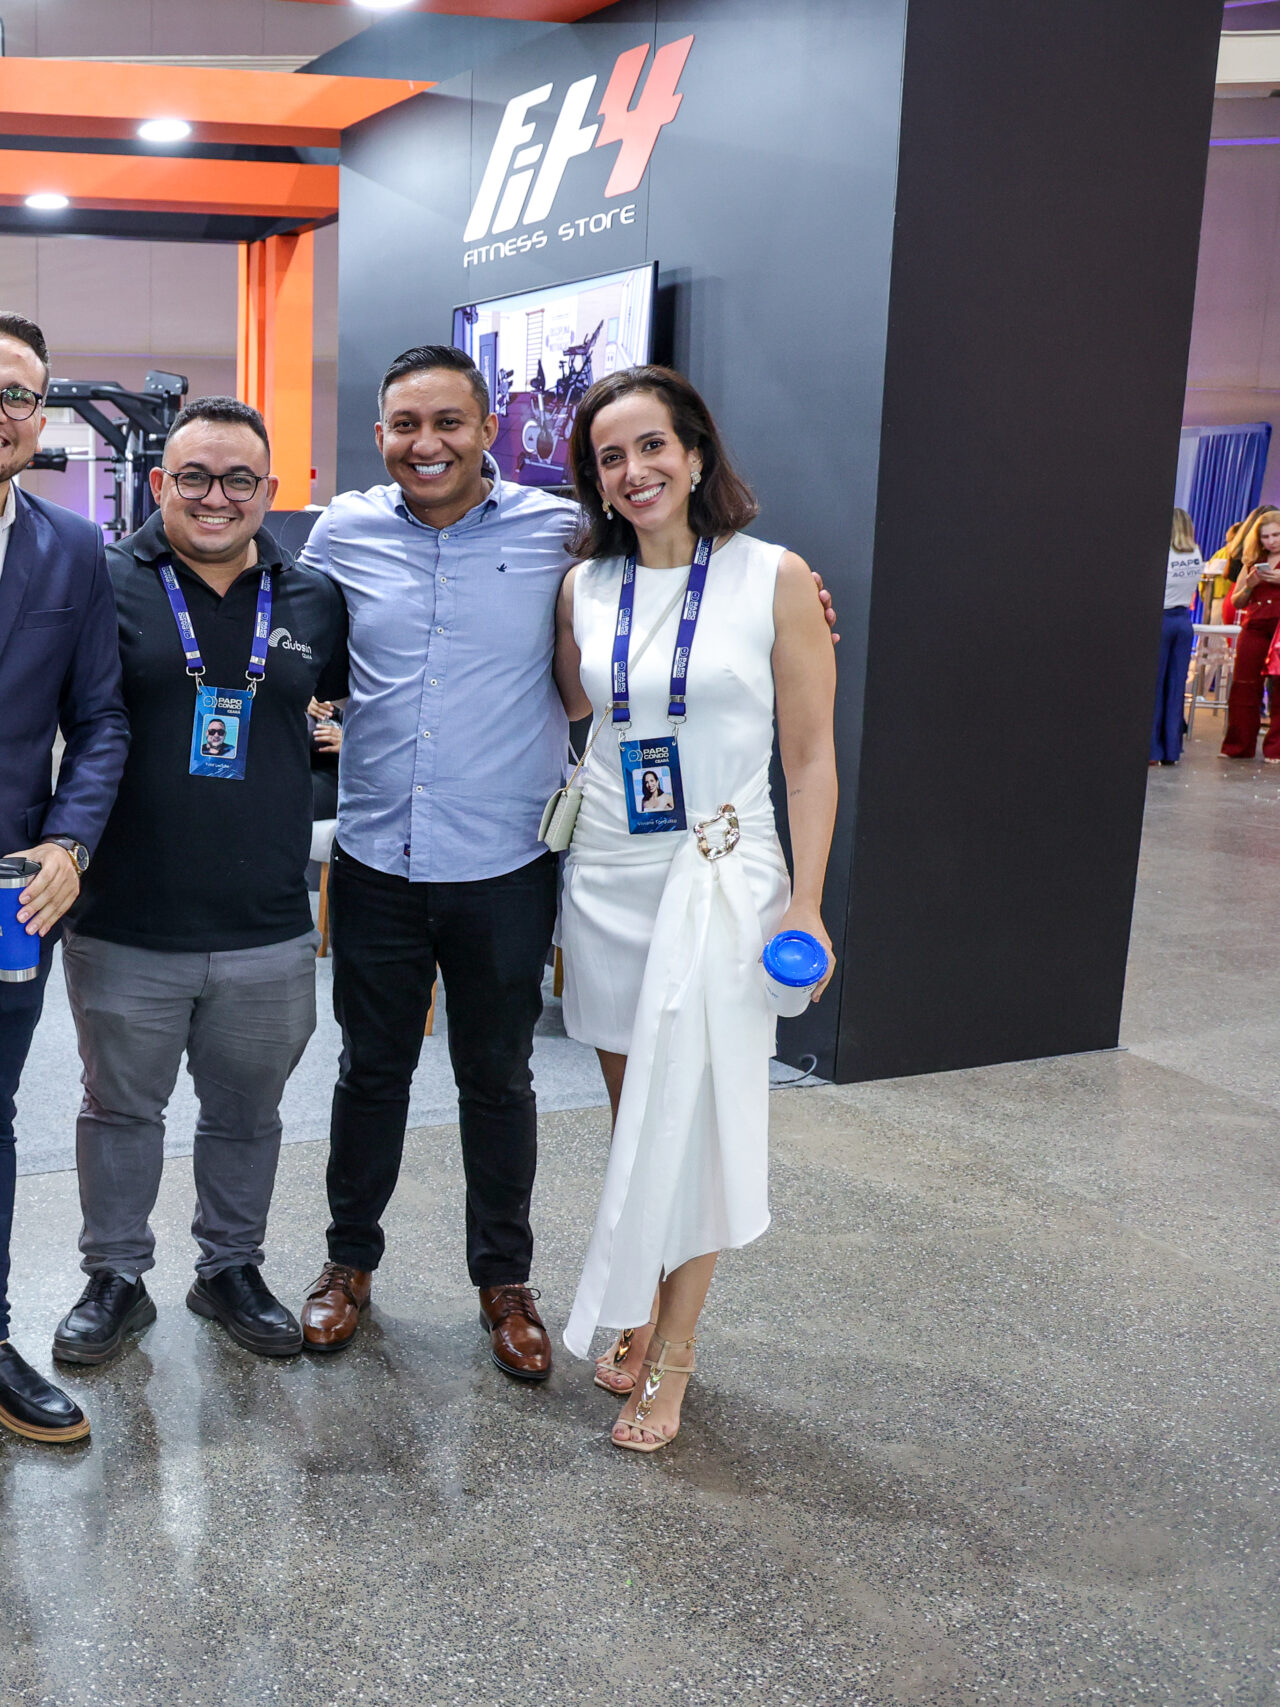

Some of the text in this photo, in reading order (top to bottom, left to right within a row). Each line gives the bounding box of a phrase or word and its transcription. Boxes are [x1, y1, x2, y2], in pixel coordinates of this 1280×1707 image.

[463, 204, 636, 268] FITNESS STORE
[282, 639, 312, 654] dubsin
[218, 697, 242, 705] PAPO
[643, 746, 669, 754] PAPO
[643, 752, 670, 760] CONDO
